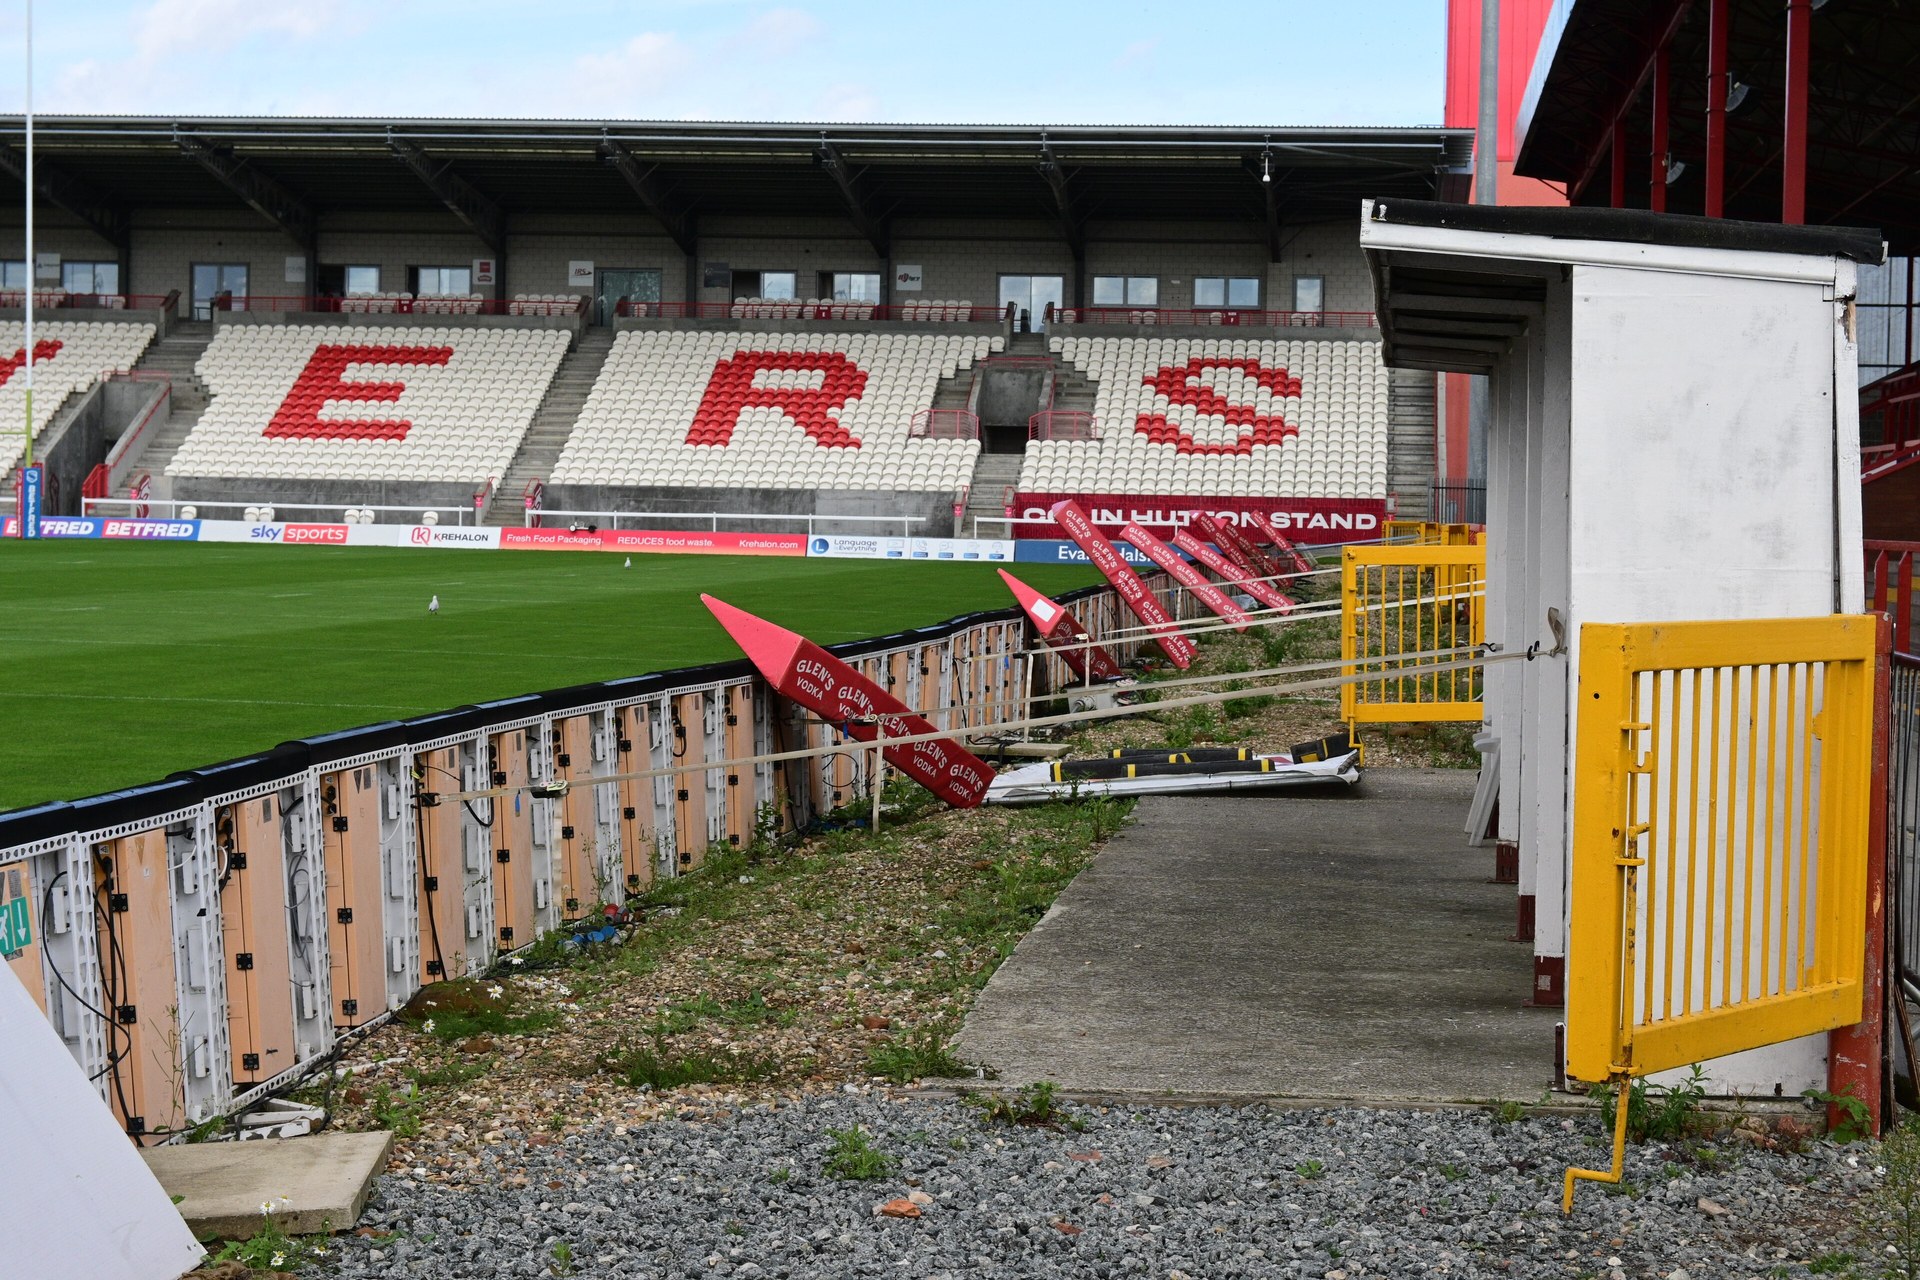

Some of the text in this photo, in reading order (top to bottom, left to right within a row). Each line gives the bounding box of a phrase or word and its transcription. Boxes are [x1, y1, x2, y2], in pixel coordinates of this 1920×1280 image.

[262, 344, 1302, 456] E R S
[7, 520, 94, 535] BFRED
[105, 522, 193, 537] BETFRED
[1023, 508, 1123, 524] CIN
[1270, 512, 1377, 529] STAND
[1065, 518, 1083, 540] VODKA
[1066, 510, 1092, 538] GLEN'S
[251, 525, 344, 541] sky sports
[434, 533, 489, 542] KREHALON
[507, 534, 604, 545] Fresh Food Packaging.
[617, 536, 798, 549] REDUCES food waste. Krehalon.com
[834, 539, 878, 547] Language
[1128, 527, 1152, 546] GLEN'S
[1178, 535, 1199, 551] GLEN'S
[1058, 545, 1090, 561] Eva
[1092, 540, 1118, 568] GLEN'S
[1092, 548, 1110, 570] VODKA
[1152, 545, 1176, 565] GLEN'S
[1201, 549, 1222, 566] GLEN'S
[1176, 564, 1199, 584] GLEN'S
[1222, 564, 1244, 580] GLEN'S
[1117, 578, 1135, 600] VODKA
[1118, 570, 1143, 599] GLEN'S
[1166, 640, 1183, 662] VODKA
[1168, 634, 1191, 662] GLEN'S
[796, 659, 835, 691] GLEN'S
[796, 676, 824, 700] VODKA
[838, 686, 874, 719] GLEN'S
[914, 740, 948, 769] GLEN'S
[912, 755, 937, 778] VODKA
[949, 764, 984, 793] GLEN'S
[949, 780, 974, 802] VODKA
